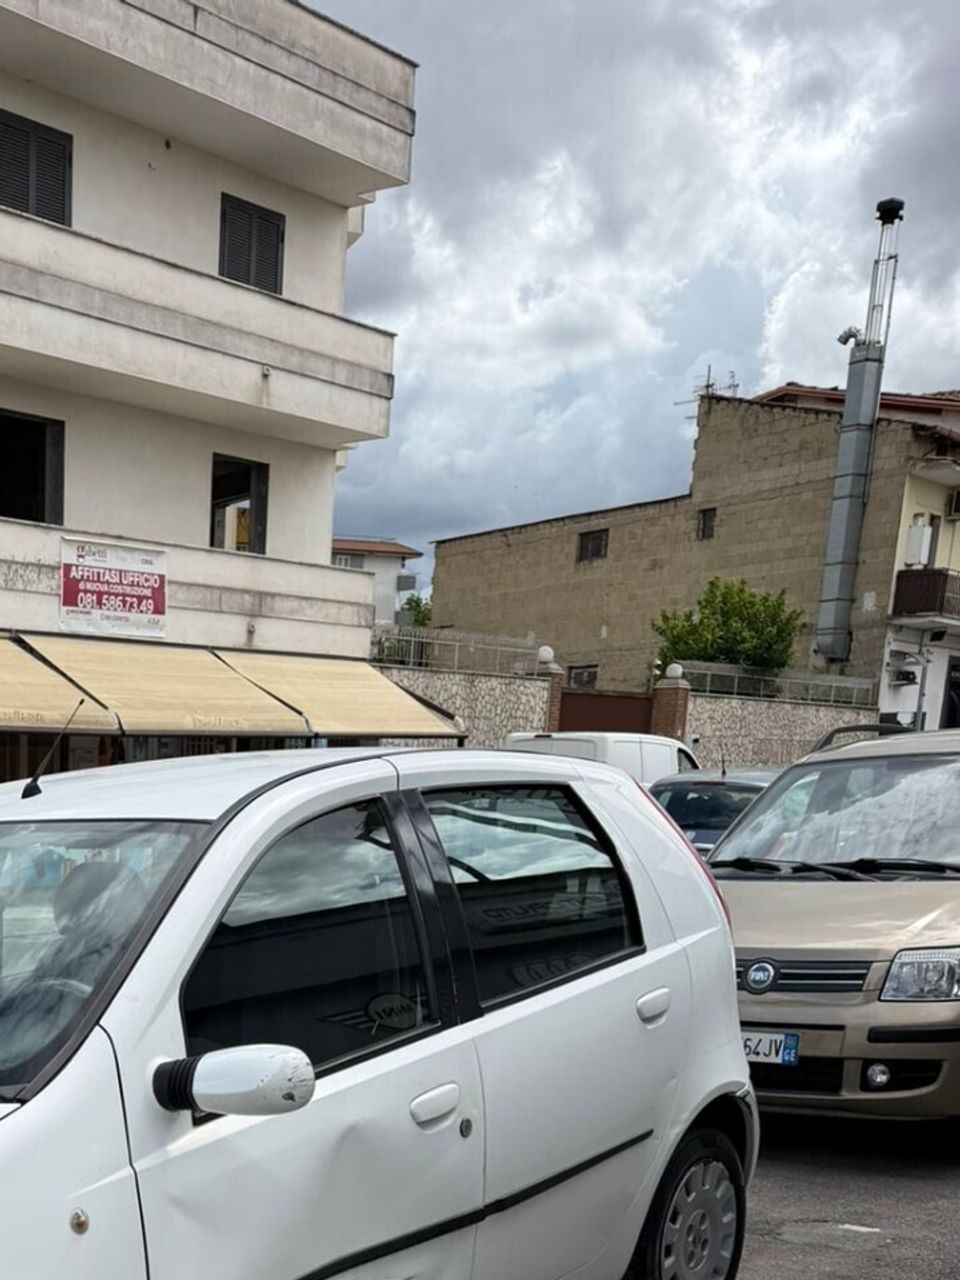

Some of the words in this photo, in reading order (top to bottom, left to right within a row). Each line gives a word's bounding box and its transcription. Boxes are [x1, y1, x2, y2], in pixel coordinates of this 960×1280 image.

[69, 565, 120, 583] AFFITTASI
[121, 573, 160, 588] UFFICIO
[750, 971, 769, 981] FIAT
